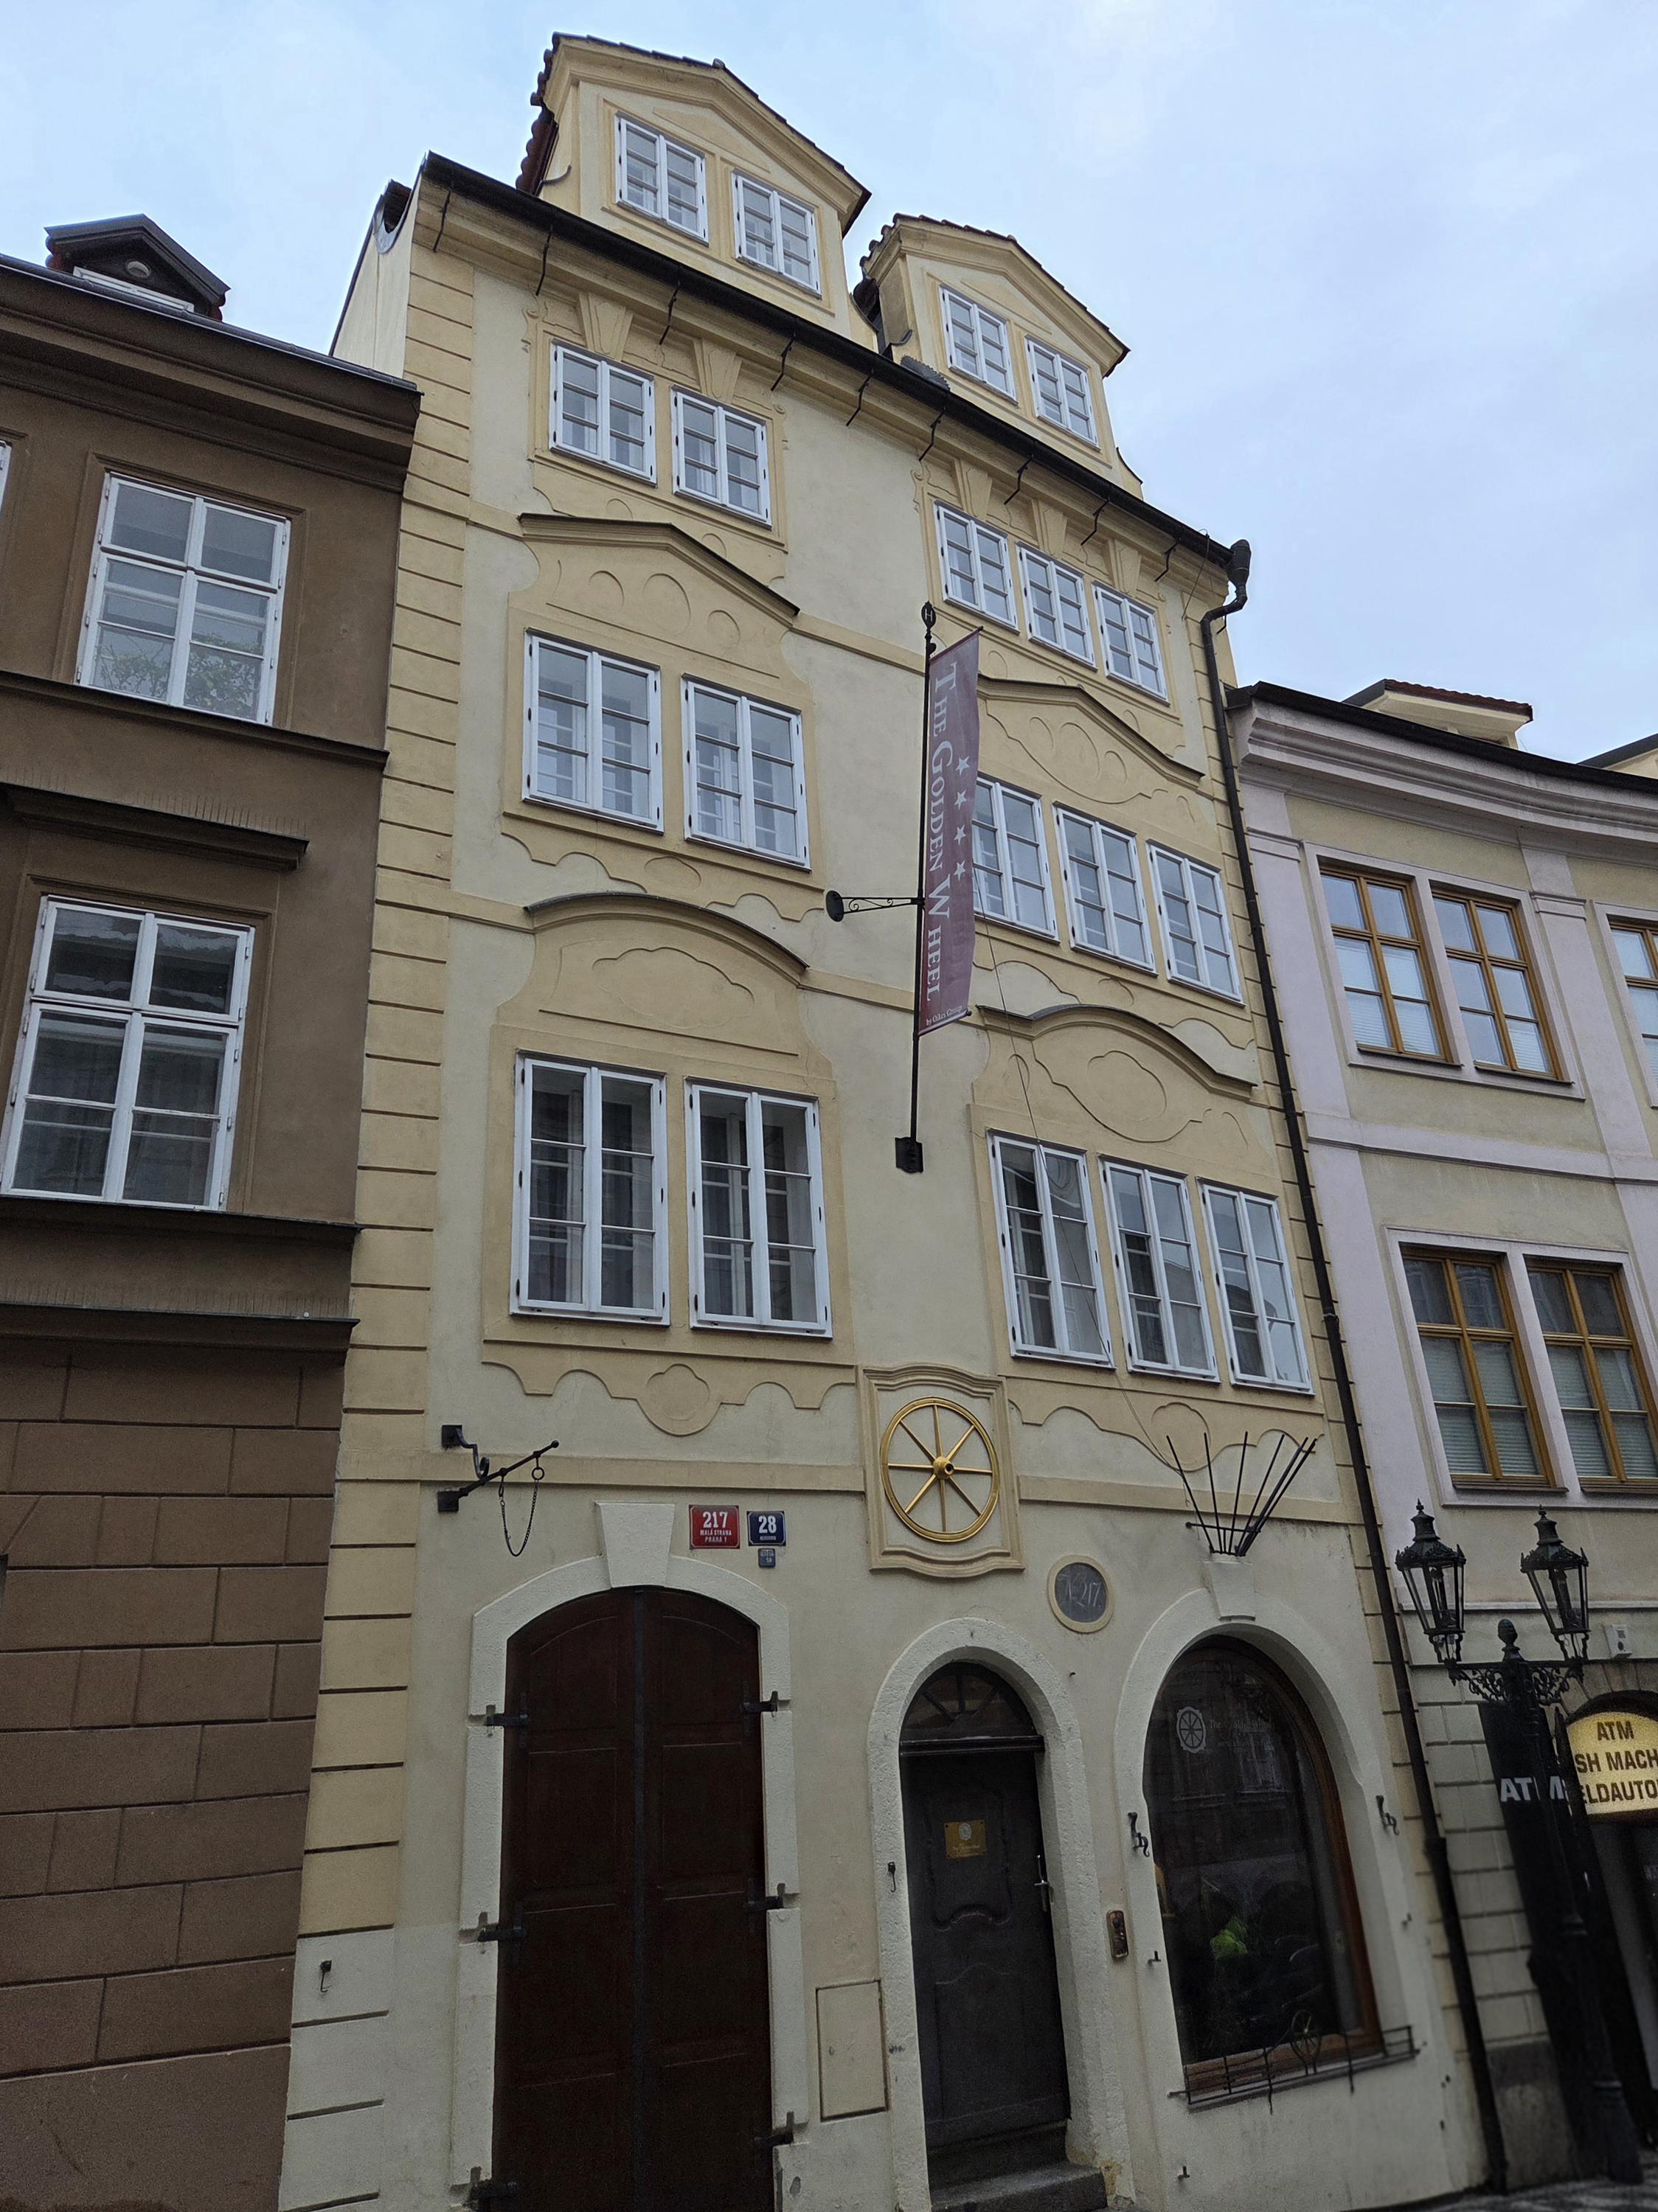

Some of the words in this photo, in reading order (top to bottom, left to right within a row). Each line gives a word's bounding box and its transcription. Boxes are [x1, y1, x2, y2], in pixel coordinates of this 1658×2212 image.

[932, 661, 957, 737] THE
[929, 740, 953, 870] GOLDEN
[702, 1511, 728, 1528] 217
[758, 1515, 777, 1534] 28
[1596, 1720, 1634, 1741] ATM
